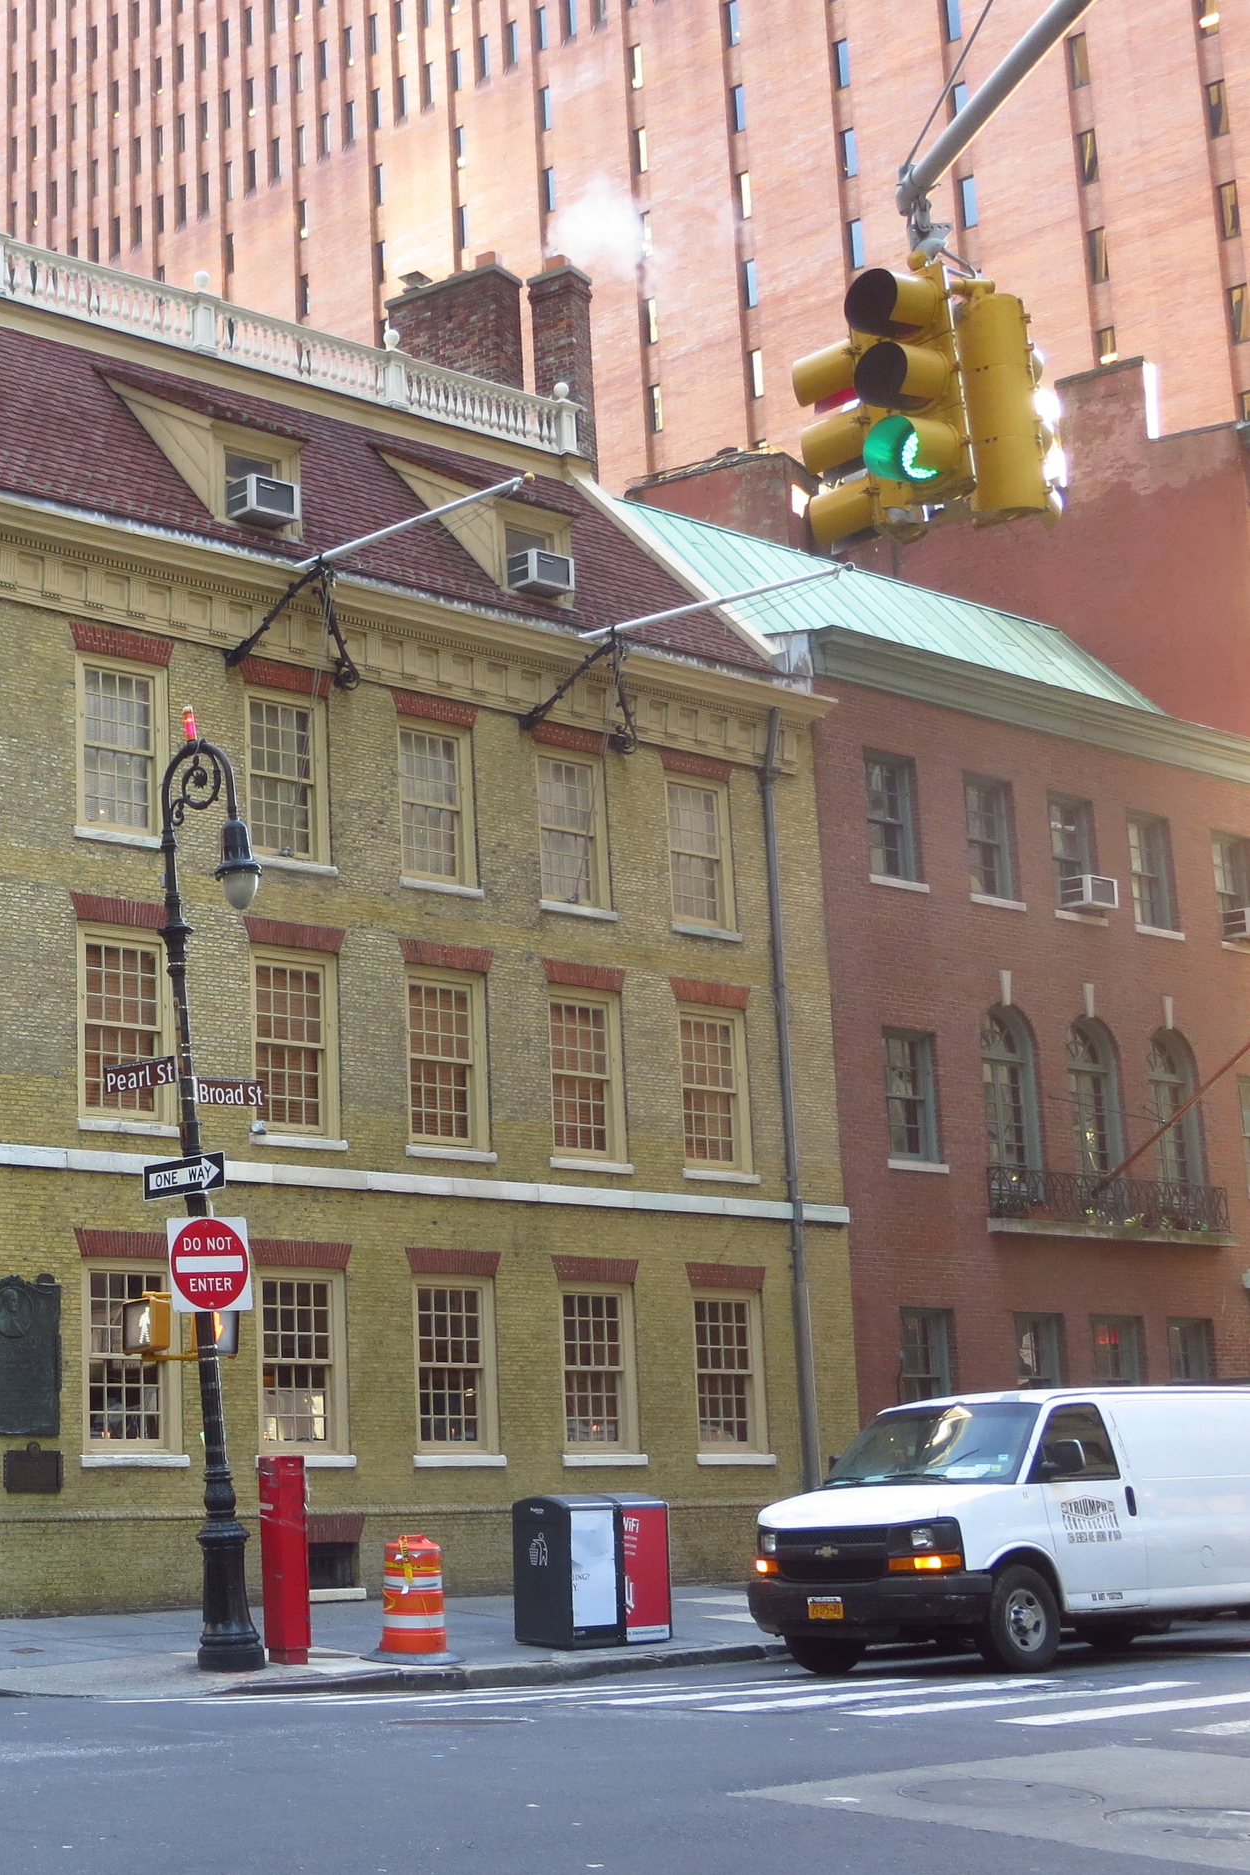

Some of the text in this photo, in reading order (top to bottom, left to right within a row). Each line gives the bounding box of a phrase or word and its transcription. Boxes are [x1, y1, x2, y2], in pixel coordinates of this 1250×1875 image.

[106, 1062, 174, 1093] Pearl St
[199, 1083, 264, 1106] Broad St
[155, 1165, 213, 1187] ONE WAY
[183, 1236, 233, 1251] DO NOT
[189, 1277, 233, 1292] ENTER
[1068, 1498, 1108, 1516] TRIUMPH
[1062, 1511, 1120, 1531] CONSTRUCTION
